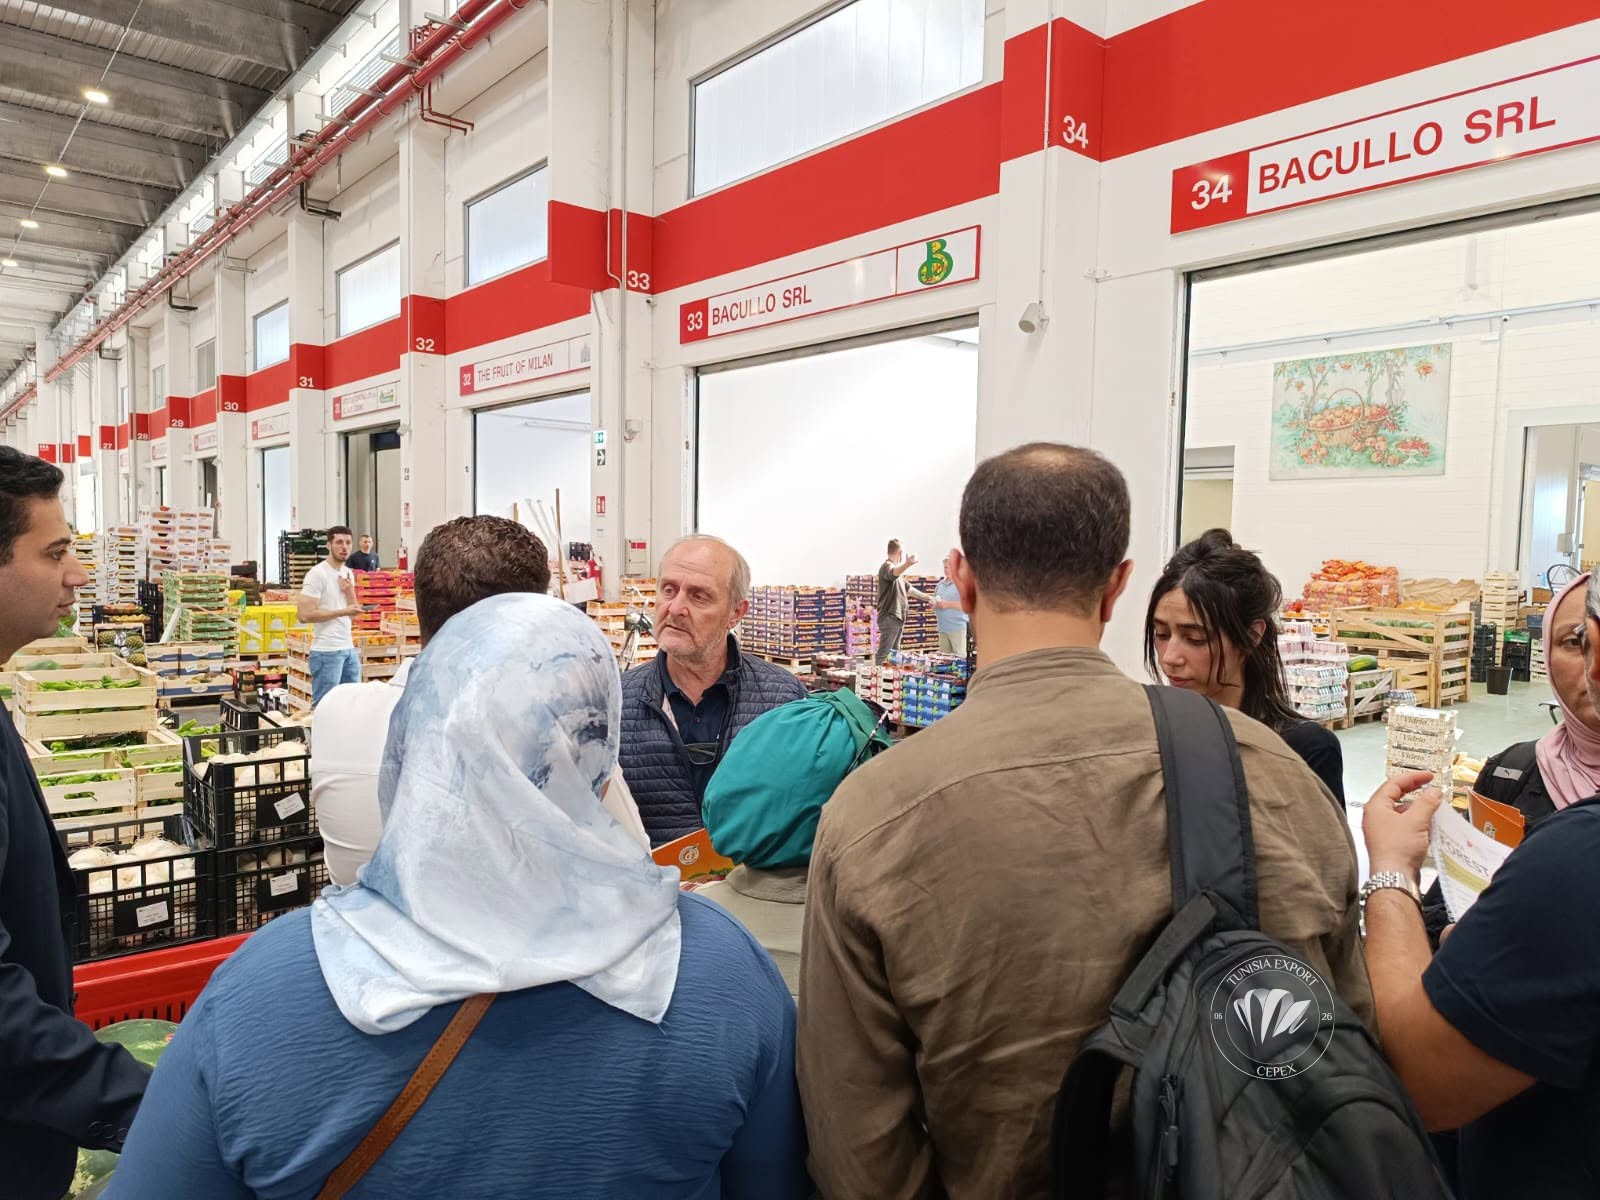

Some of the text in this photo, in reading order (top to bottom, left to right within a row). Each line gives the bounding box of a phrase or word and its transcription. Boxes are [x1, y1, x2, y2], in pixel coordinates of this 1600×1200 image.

[1062, 115, 1089, 149] 34
[1191, 96, 1556, 210] 34 BACULLO SRL
[627, 270, 650, 290] 33
[687, 285, 812, 331] 33 BACULLO SRL
[415, 337, 435, 352] 32
[462, 353, 553, 386] 32 THE FRUIT OF MILAN
[299, 376, 315, 388] 31
[224, 401, 239, 411] 30
[171, 419, 184, 427] 29
[137, 432, 148, 440] 28
[1403, 735, 1426, 743] Vidrio
[1401, 752, 1425, 761] Vidrio
